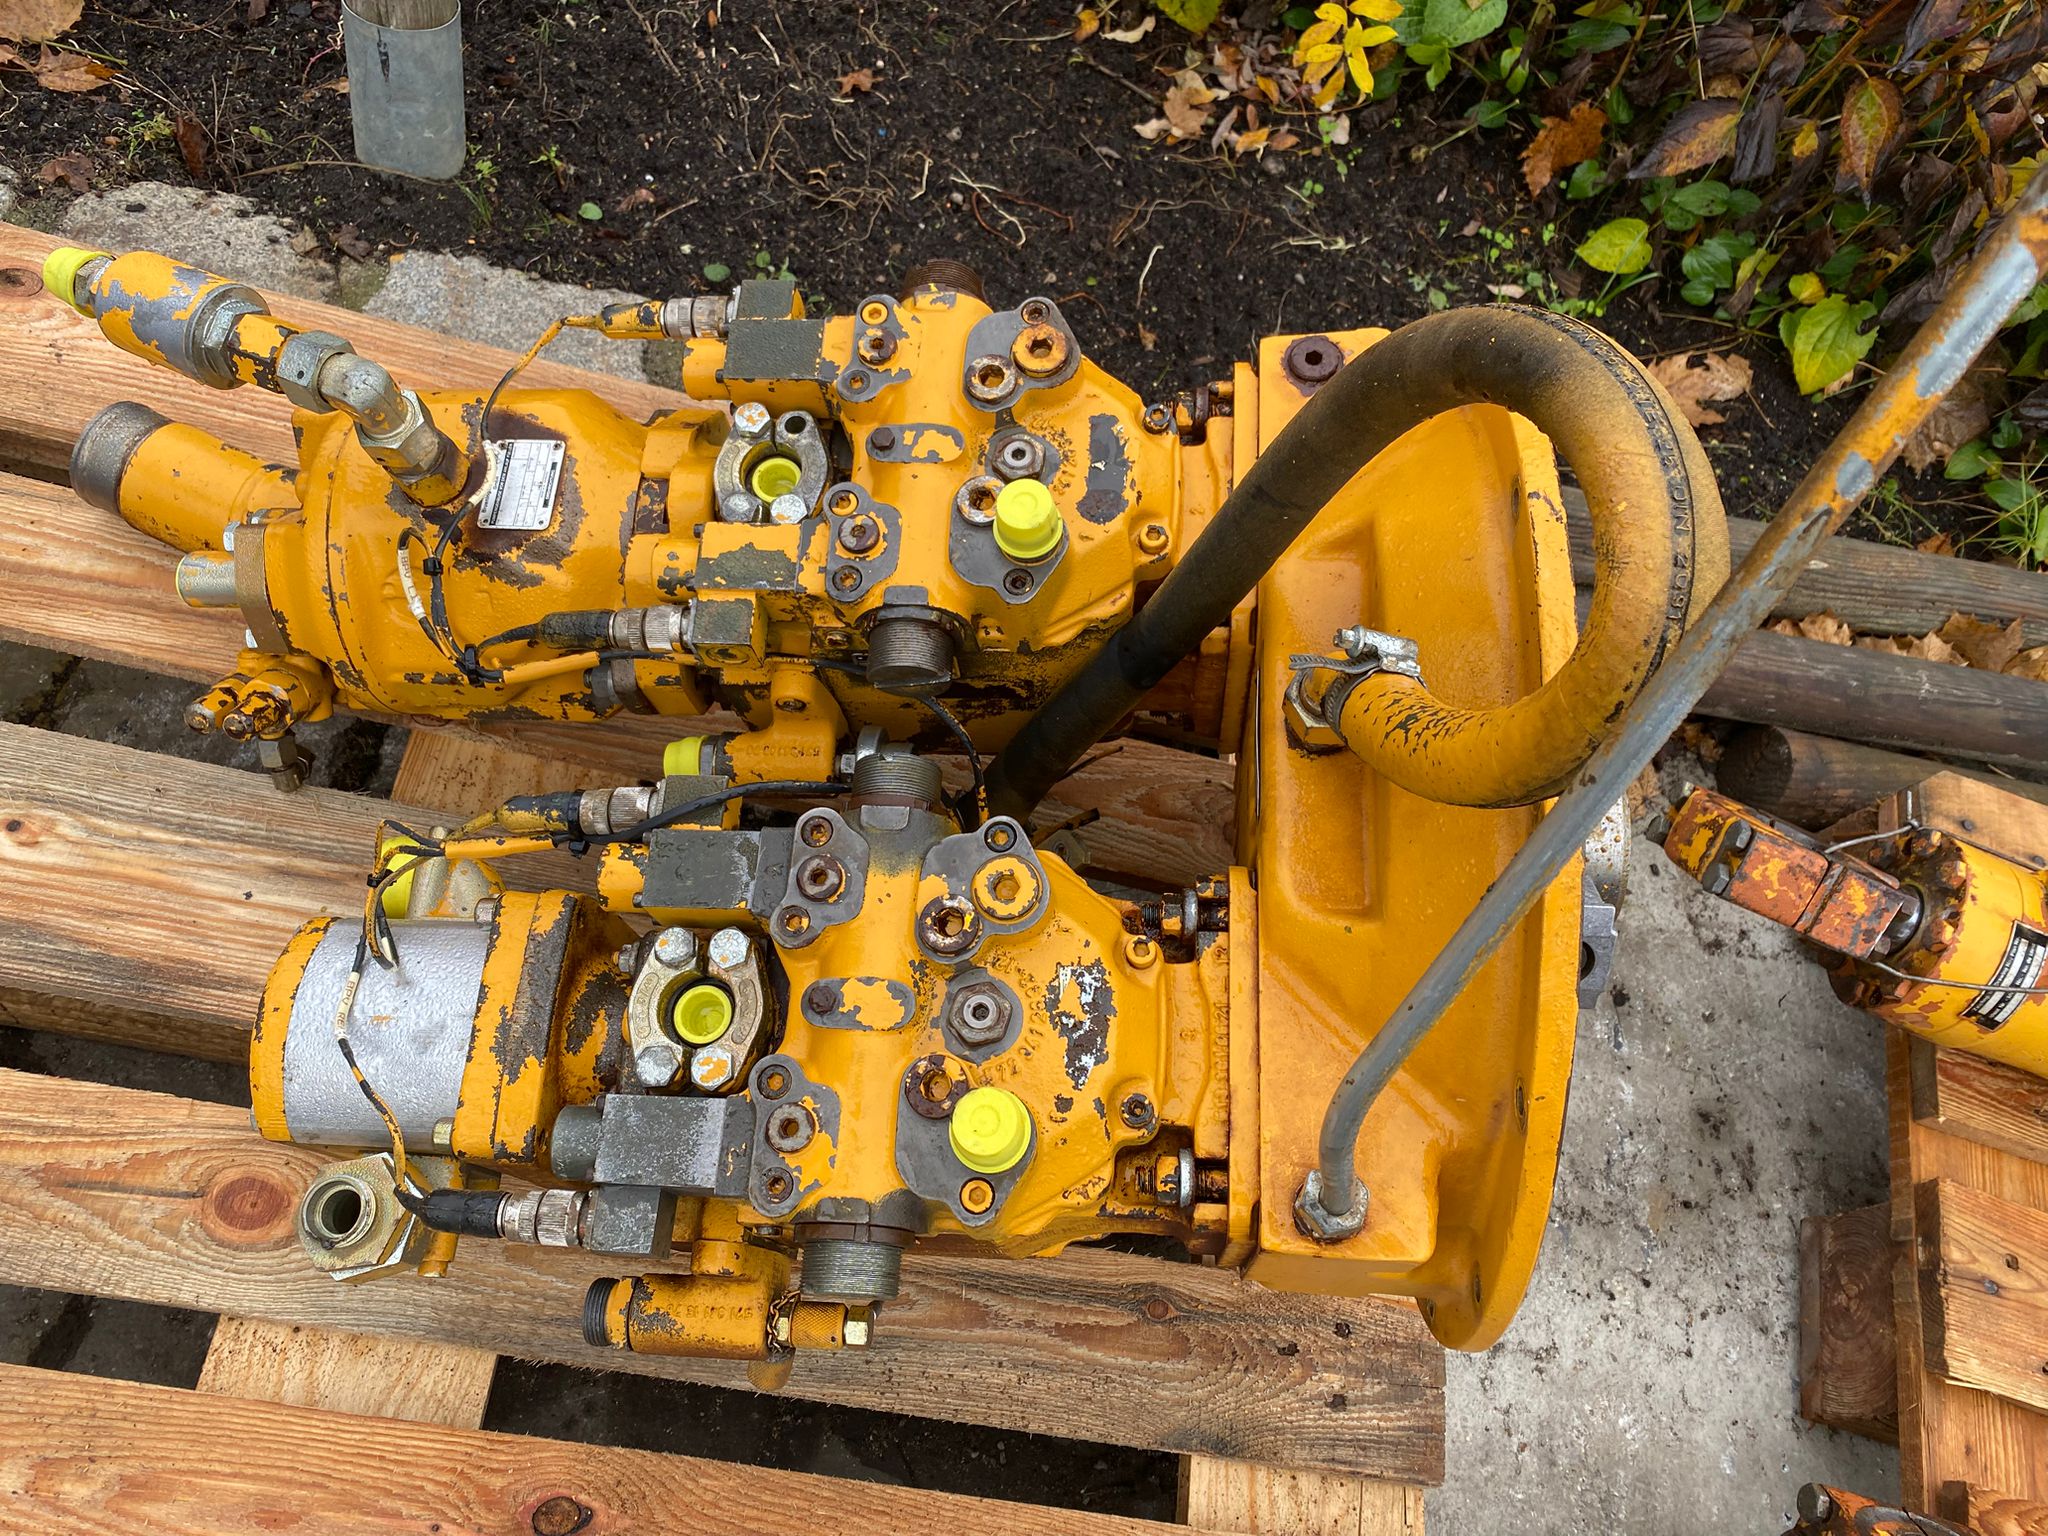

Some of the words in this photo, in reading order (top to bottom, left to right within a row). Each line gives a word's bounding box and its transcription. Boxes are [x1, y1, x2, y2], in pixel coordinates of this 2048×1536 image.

[1670, 483, 1691, 532] DIN
[401, 556, 411, 578] BPV
[342, 981, 355, 1005] BPV
